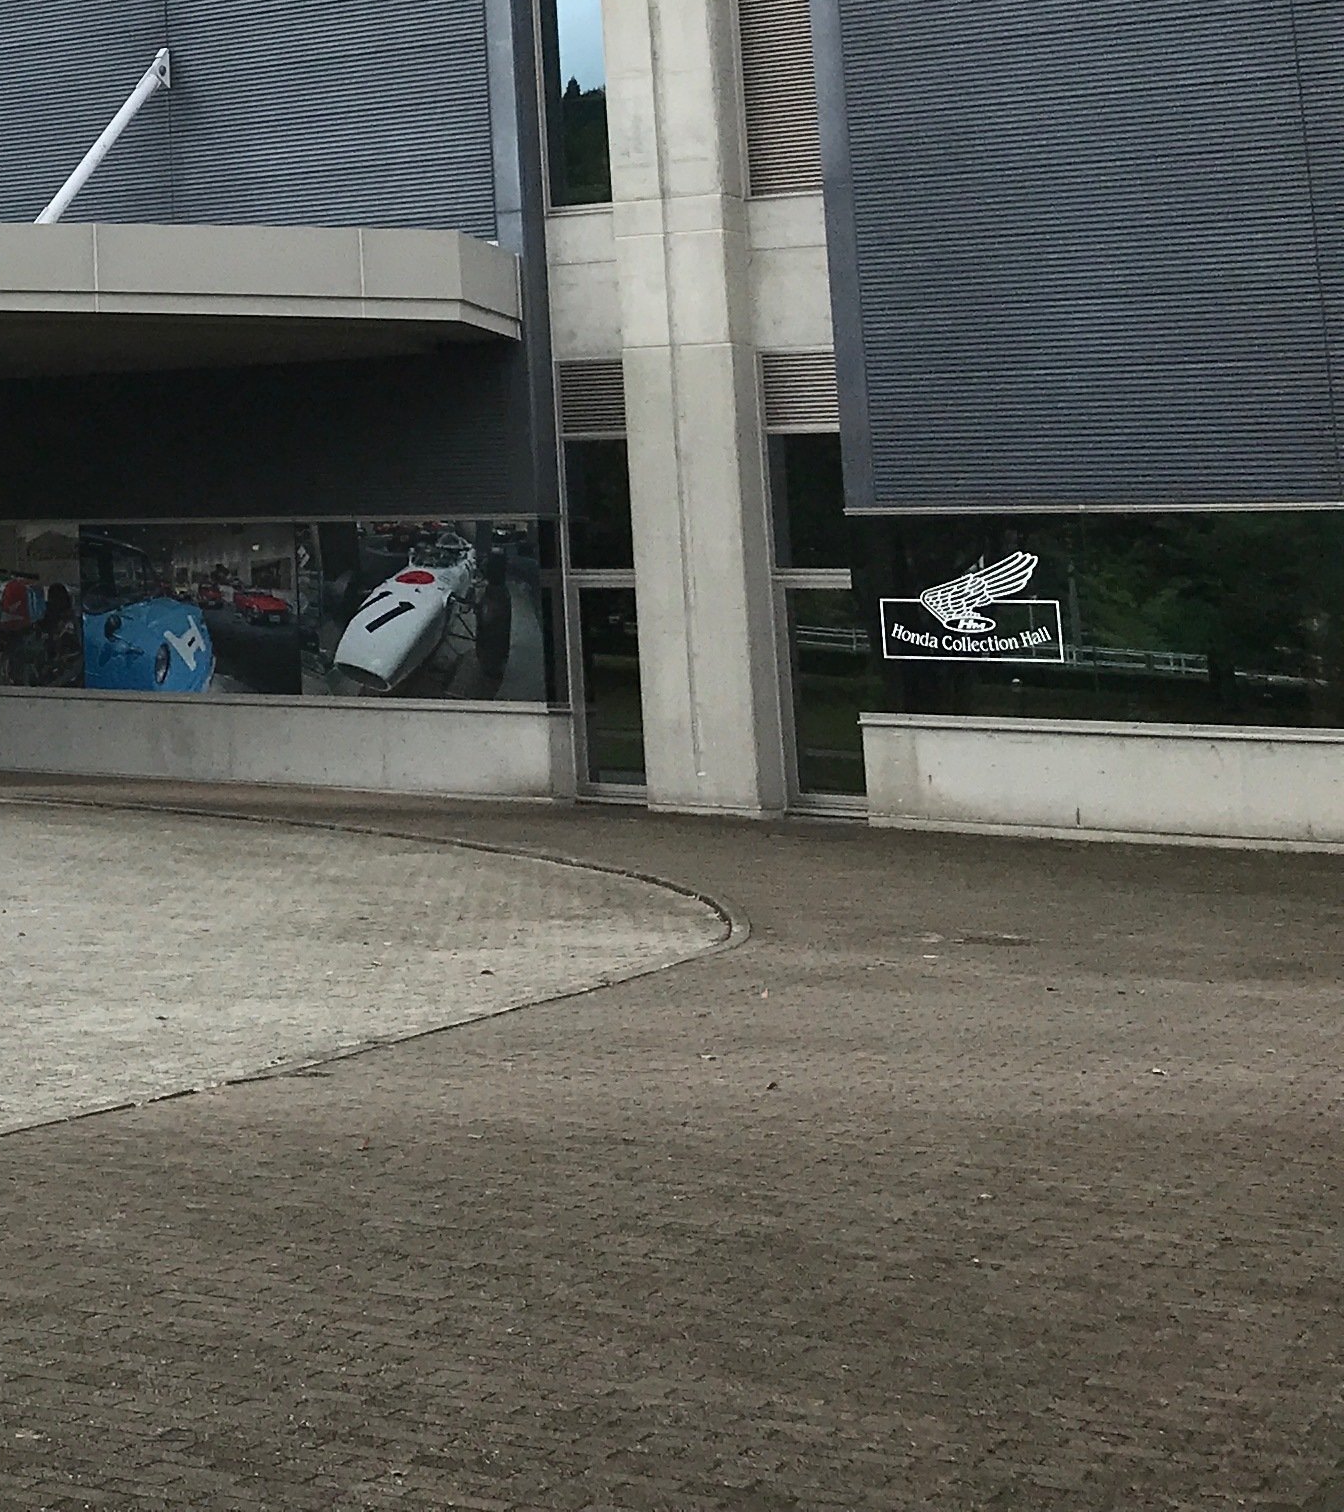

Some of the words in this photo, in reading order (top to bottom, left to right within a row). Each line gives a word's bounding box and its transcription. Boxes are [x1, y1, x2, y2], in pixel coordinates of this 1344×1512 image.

[891, 623, 939, 649] Honda
[941, 635, 1018, 652] Collection
[1020, 626, 1052, 649] Hall
